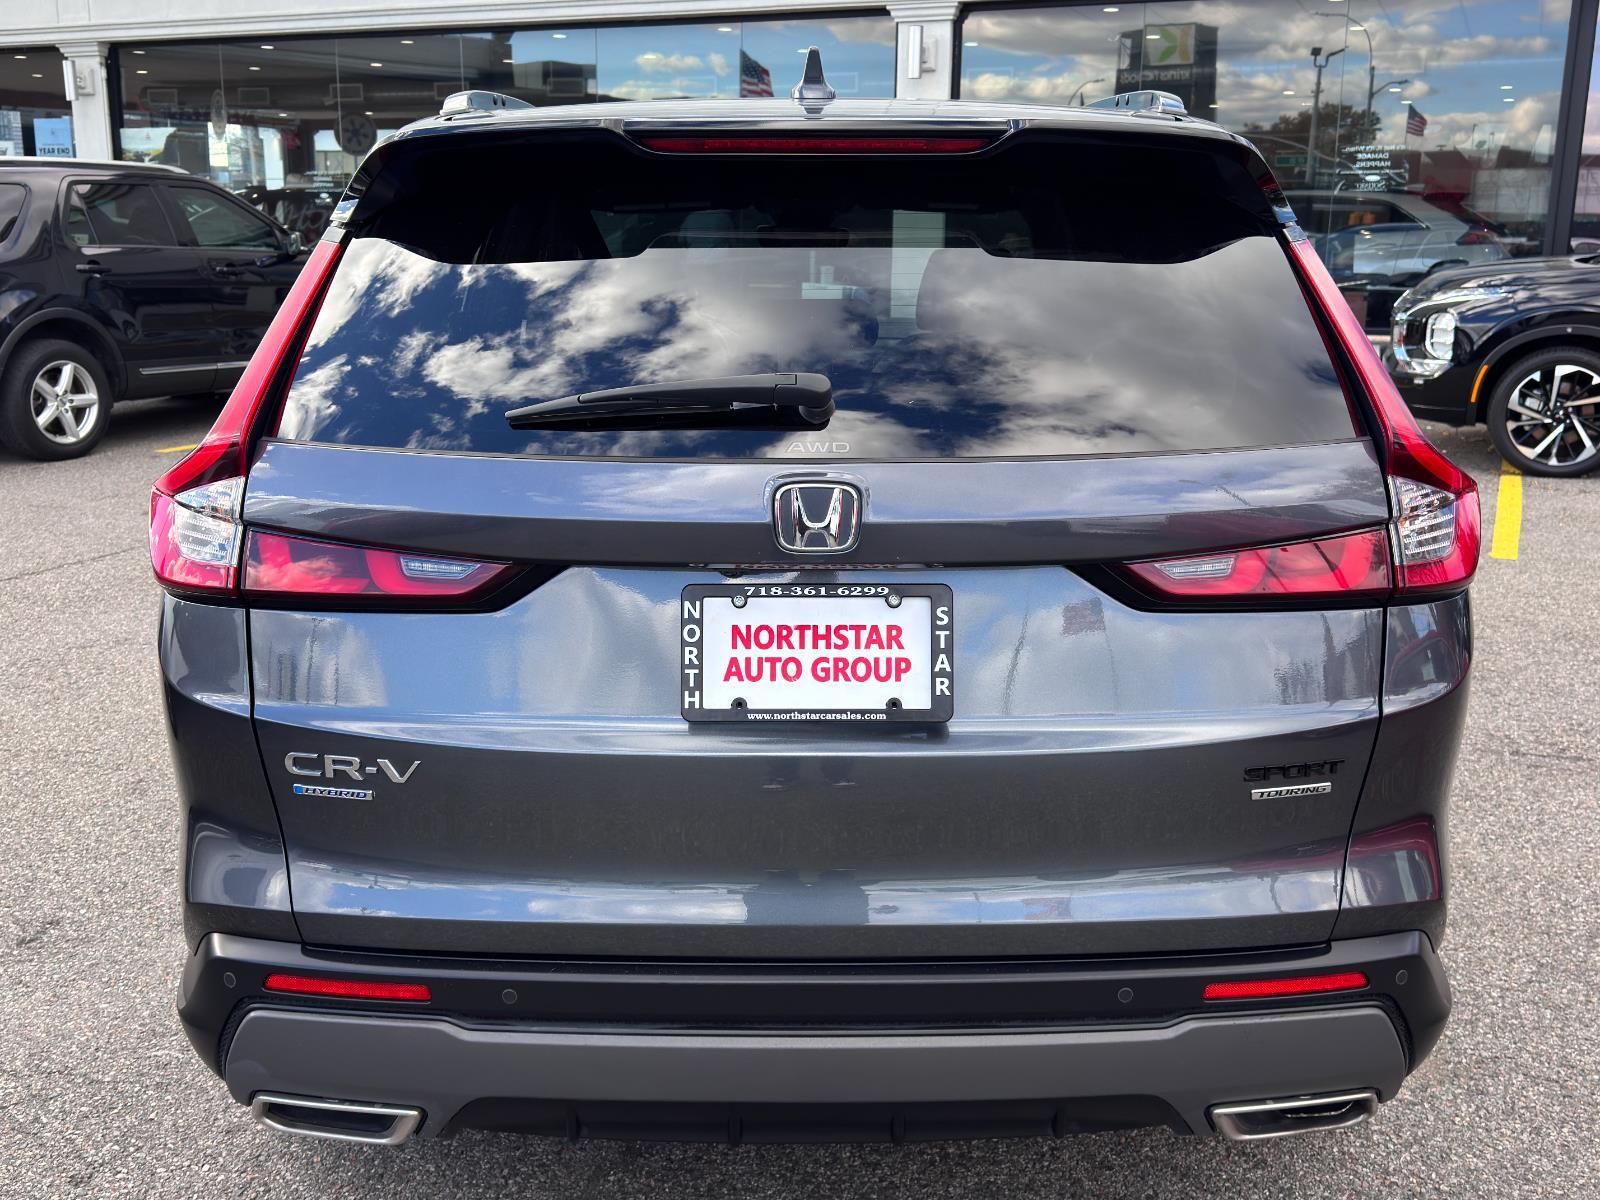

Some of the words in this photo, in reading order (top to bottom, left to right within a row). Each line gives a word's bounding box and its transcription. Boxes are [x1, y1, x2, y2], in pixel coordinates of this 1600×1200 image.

[56, 147, 70, 155] END
[786, 442, 850, 452] AWD
[744, 586, 890, 596] 718-361-6299
[731, 624, 905, 650] NORTHSTAR
[683, 600, 701, 709] NORTH
[934, 606, 951, 696] STAR
[723, 657, 803, 682] AUTO
[811, 657, 912, 682] GROUP
[747, 712, 887, 720] www.northstarcarsales.com
[284, 751, 421, 784] CR-V
[1243, 758, 1345, 782] SPORT
[304, 787, 367, 799] HYBRID
[1257, 785, 1327, 799] TOURING
